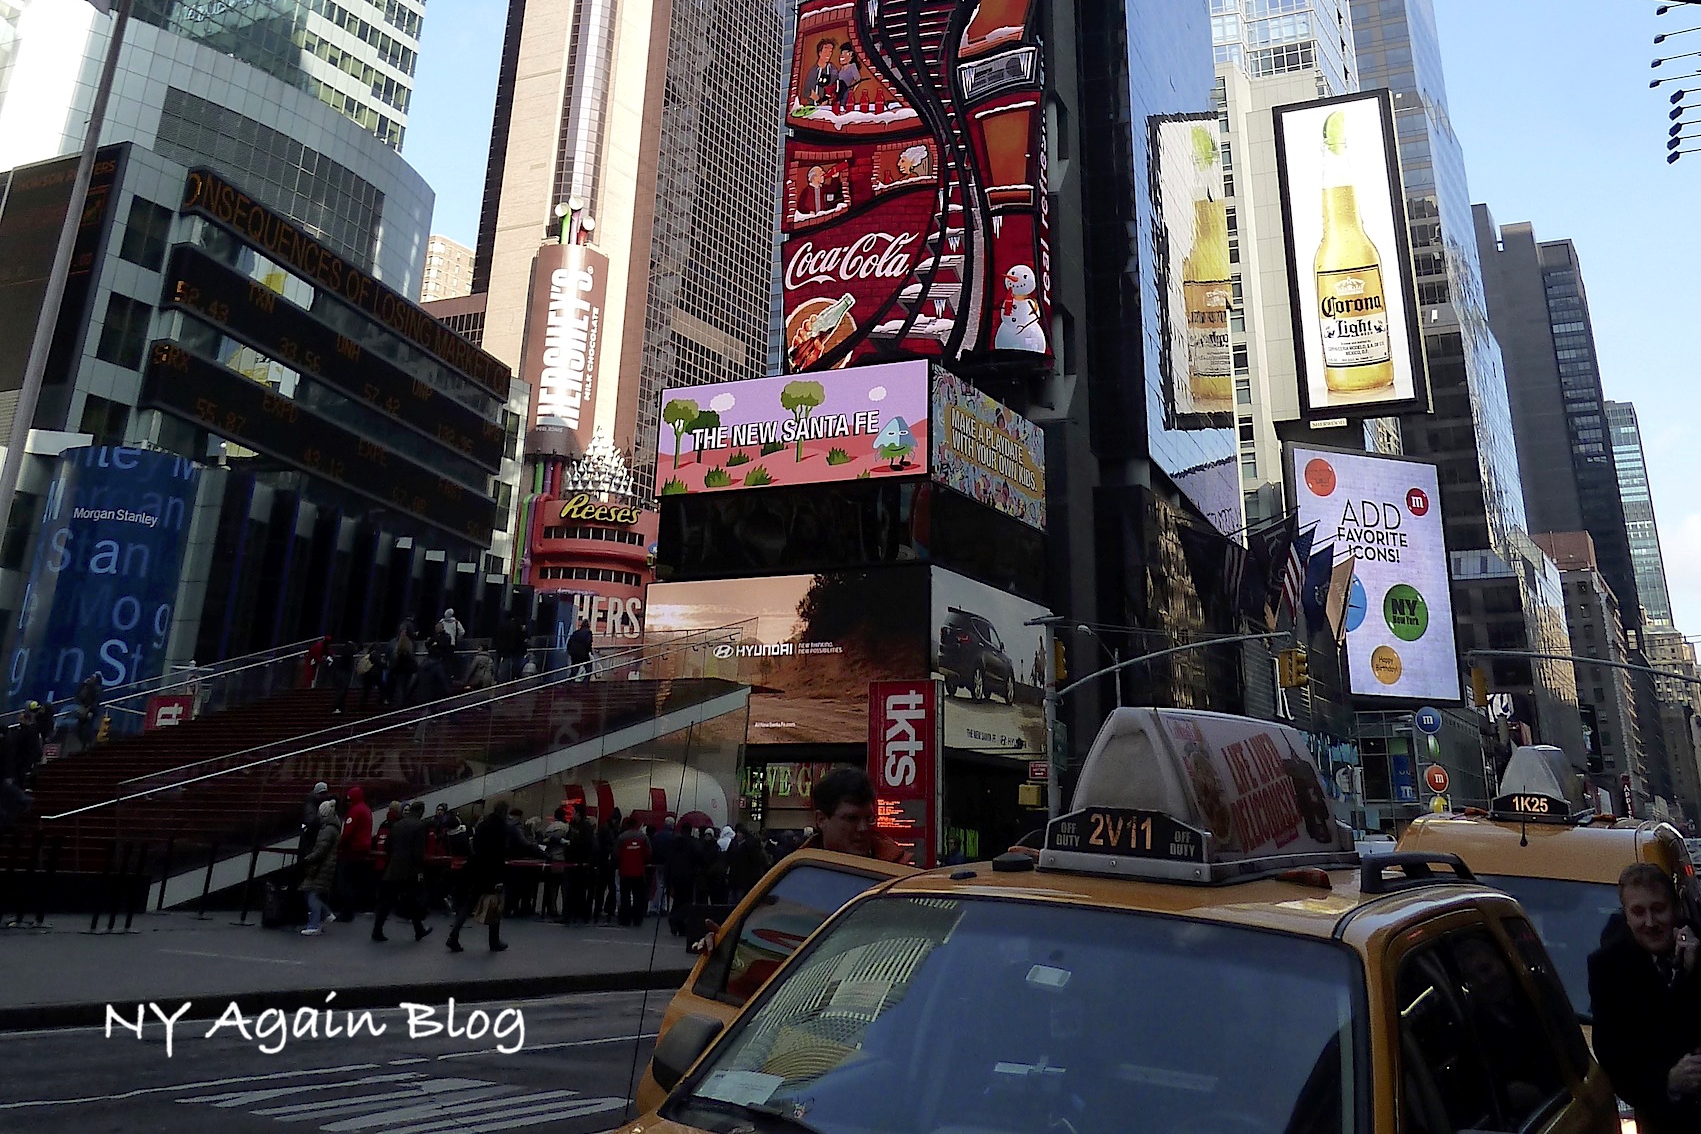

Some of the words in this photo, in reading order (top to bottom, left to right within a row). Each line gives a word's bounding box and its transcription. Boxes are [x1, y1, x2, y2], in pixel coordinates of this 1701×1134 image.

[785, 231, 919, 291] Coca-Cola
[348, 270, 371, 304] OF
[373, 282, 436, 349] LOSING
[1321, 294, 1382, 320] Corona
[587, 306, 600, 373] CHOCOLATE
[1335, 319, 1373, 338] Light
[584, 374, 593, 401] MILK
[692, 424, 729, 451] THE
[731, 421, 777, 448] NEW
[777, 413, 851, 443] SANTA
[853, 410, 880, 435] FE
[951, 409, 978, 437] MAKE
[977, 423, 986, 440] A
[986, 426, 1025, 466] PLAYDATE
[951, 426, 975, 456] WITH
[975, 438, 998, 468] YOUR
[997, 449, 1020, 479] OWN
[1017, 460, 1038, 493] KIDS.
[73, 506, 115, 521] Morgan
[115, 509, 159, 528] Stanley
[560, 493, 641, 526] Reese's
[1340, 498, 1402, 530] ADD
[1337, 526, 1408, 548] FAVORITE
[1348, 544, 1401, 564] ICONS!
[1391, 598, 1418, 617] NY
[735, 642, 794, 658] HYUNDAI
[1422, 715, 1434, 726] m
[884, 689, 926, 787] tkts
[1434, 773, 1444, 784] m
[1512, 795, 1549, 813] 1K25
[1060, 822, 1077, 834] OFF
[1089, 813, 1152, 850] 2V11
[1174, 831, 1191, 843] OFF
[1056, 834, 1080, 848] DUTY
[1169, 843, 1196, 857] DUTY
